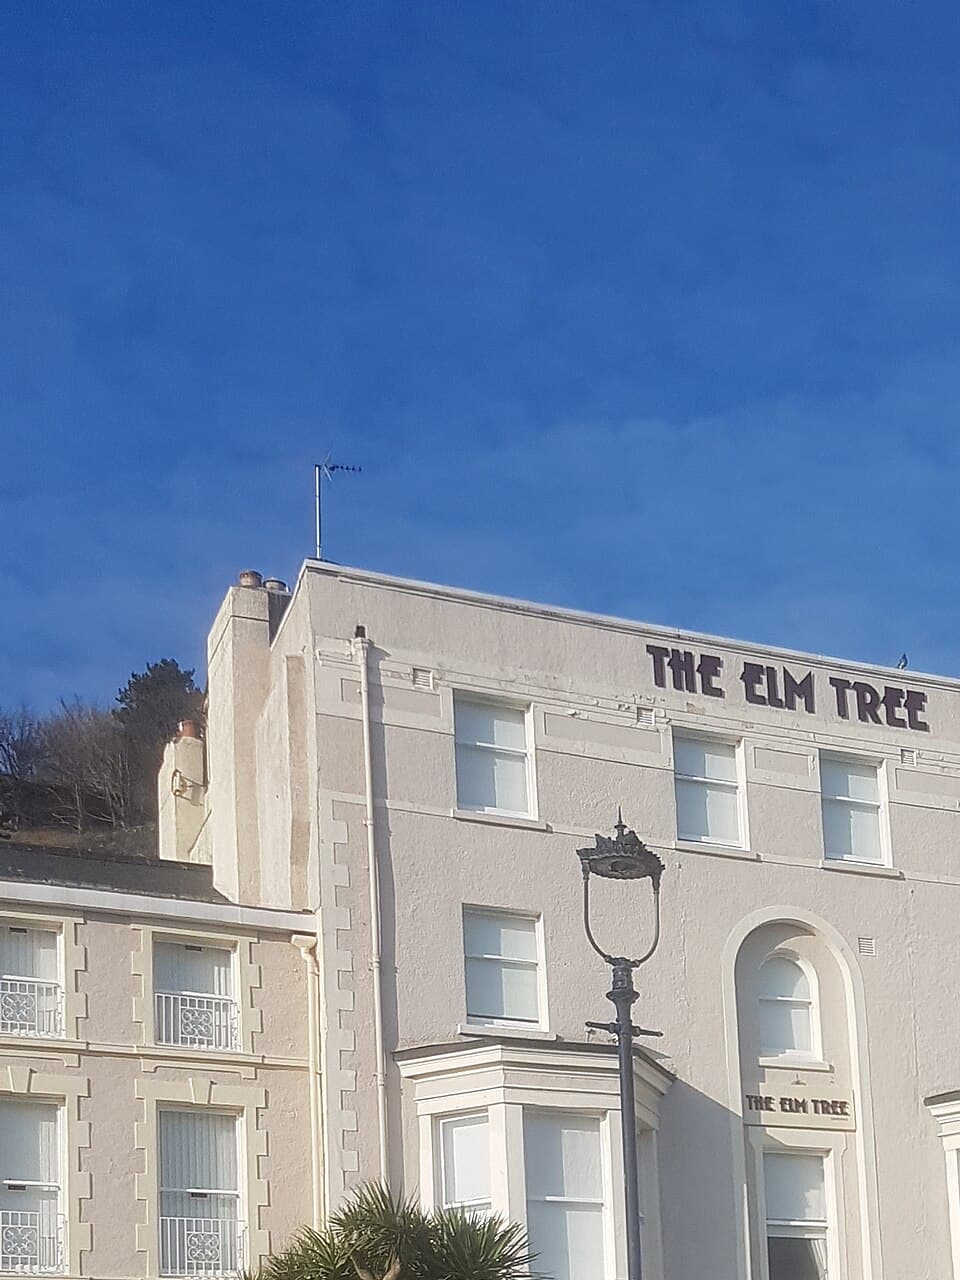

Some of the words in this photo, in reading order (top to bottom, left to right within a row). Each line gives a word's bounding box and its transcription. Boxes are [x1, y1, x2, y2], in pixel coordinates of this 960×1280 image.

[646, 645, 725, 698] THE
[740, 661, 816, 714] ELM
[829, 676, 930, 732] TREE
[746, 1094, 776, 1112] THE
[779, 1097, 808, 1114] ELM
[811, 1099, 850, 1116] TREE
